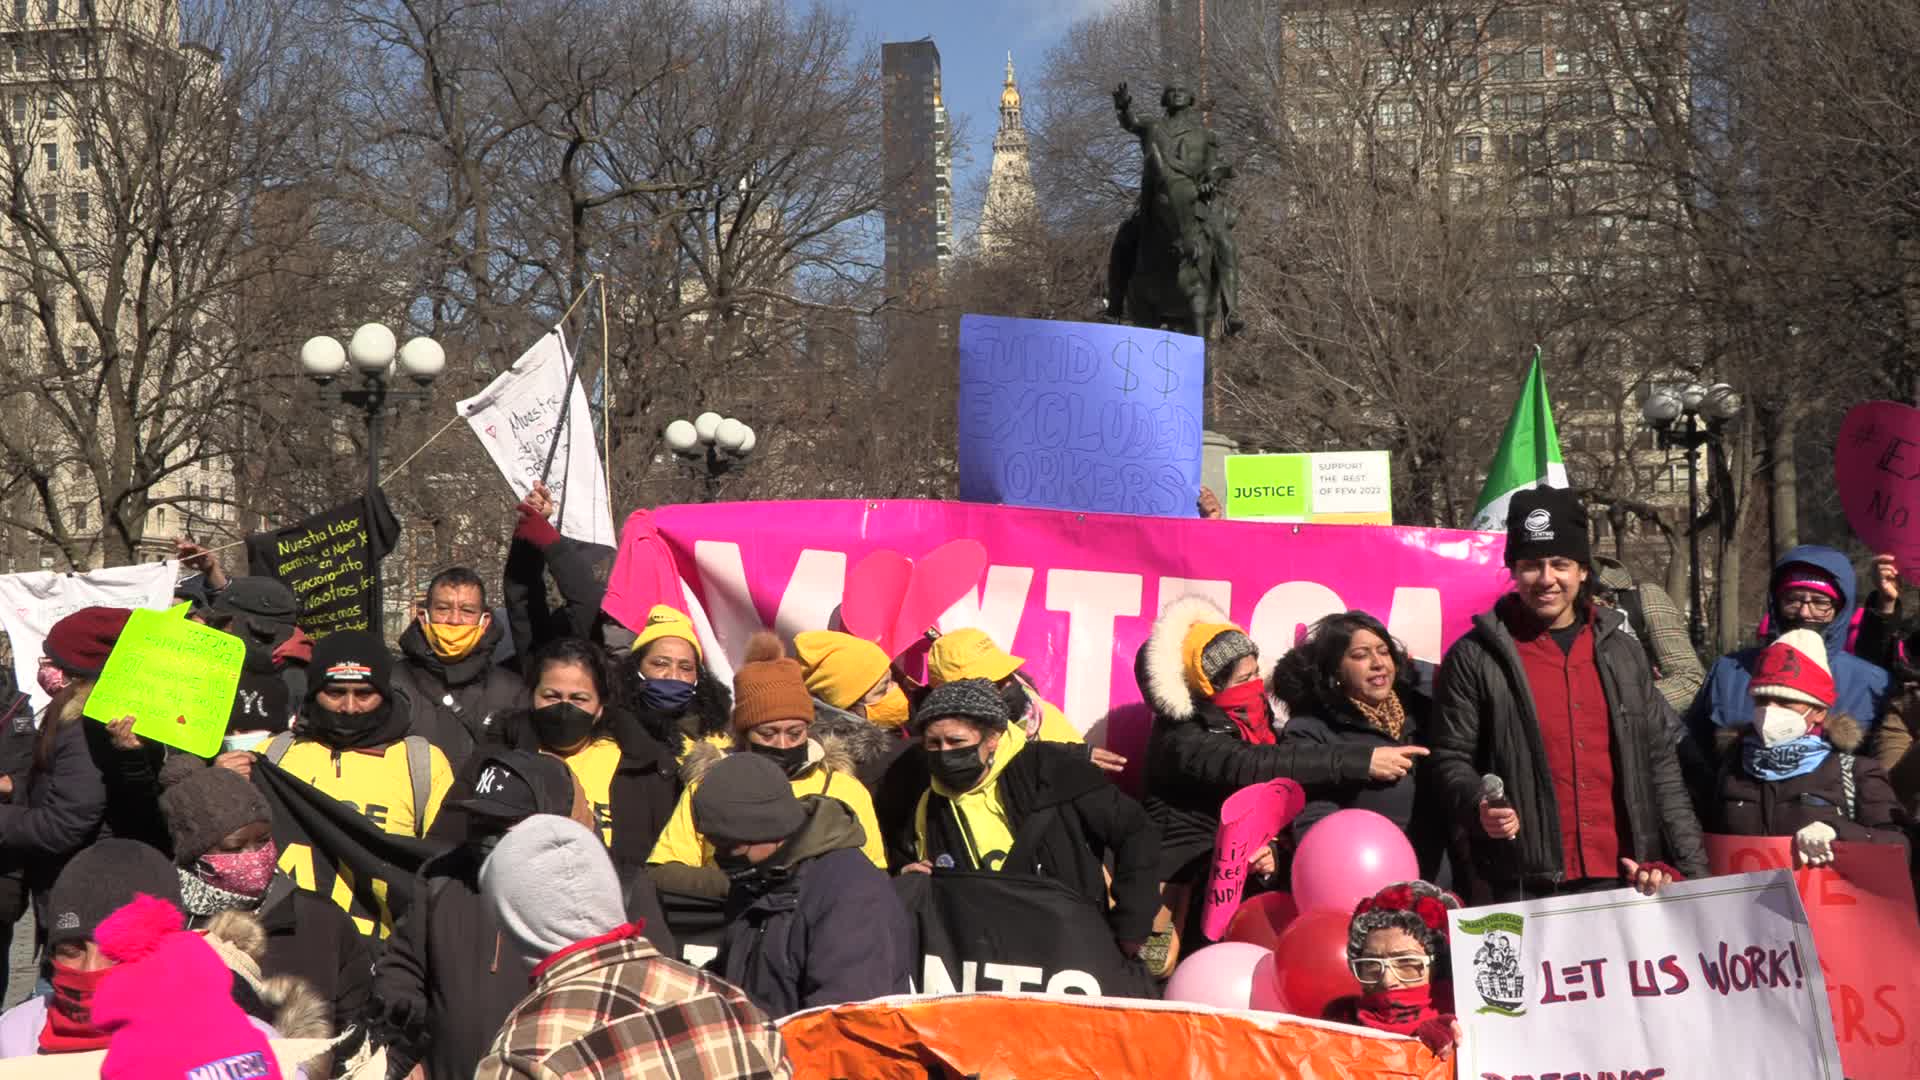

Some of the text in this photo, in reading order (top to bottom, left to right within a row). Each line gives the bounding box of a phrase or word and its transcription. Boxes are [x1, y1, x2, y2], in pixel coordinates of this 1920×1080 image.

[1318, 463, 1363, 471] SUPPORT
[1004, 450, 1187, 514] ORKERS
[1319, 474, 1367, 483] THE REST
[1234, 486, 1295, 499] JUSTICE
[1319, 487, 1333, 496] OF
[1540, 941, 1803, 1004] LET US WORK!
